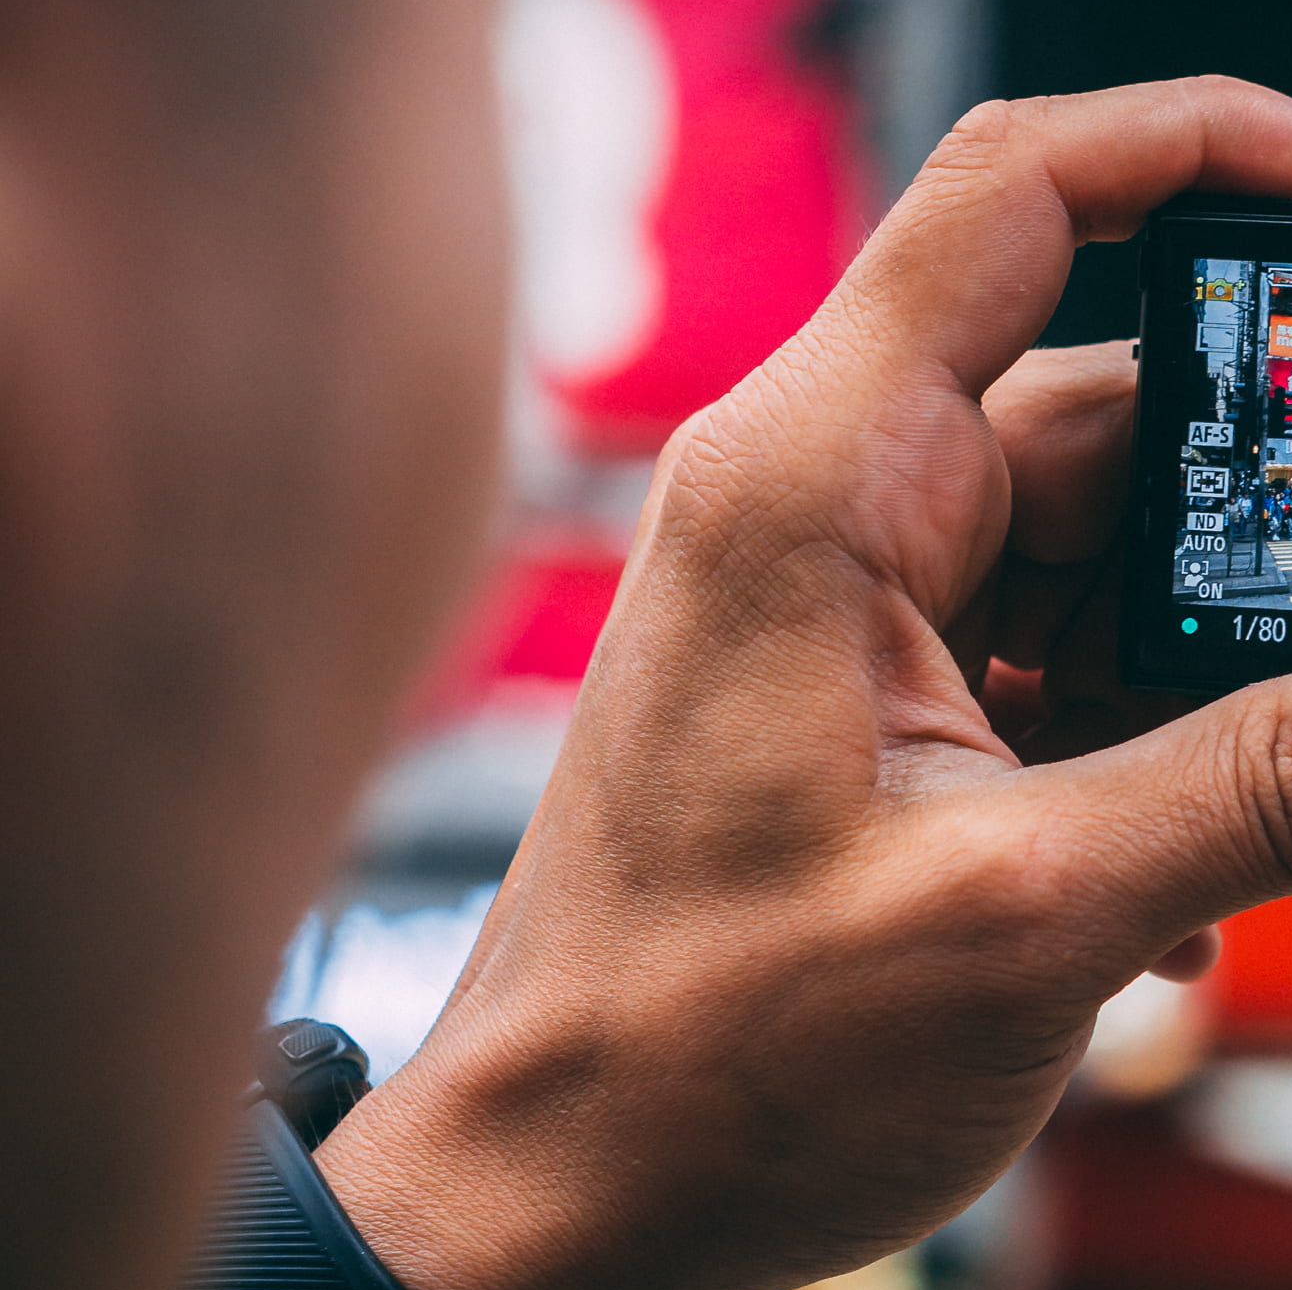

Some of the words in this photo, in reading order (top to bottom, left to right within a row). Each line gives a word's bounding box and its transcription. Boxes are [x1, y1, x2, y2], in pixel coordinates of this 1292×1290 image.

[1191, 425, 1229, 444] AF-S
[1195, 514, 1217, 530] ND
[1183, 534, 1226, 552] AUTO
[1198, 582, 1224, 600] ON
[1232, 614, 1287, 643] 1/80
